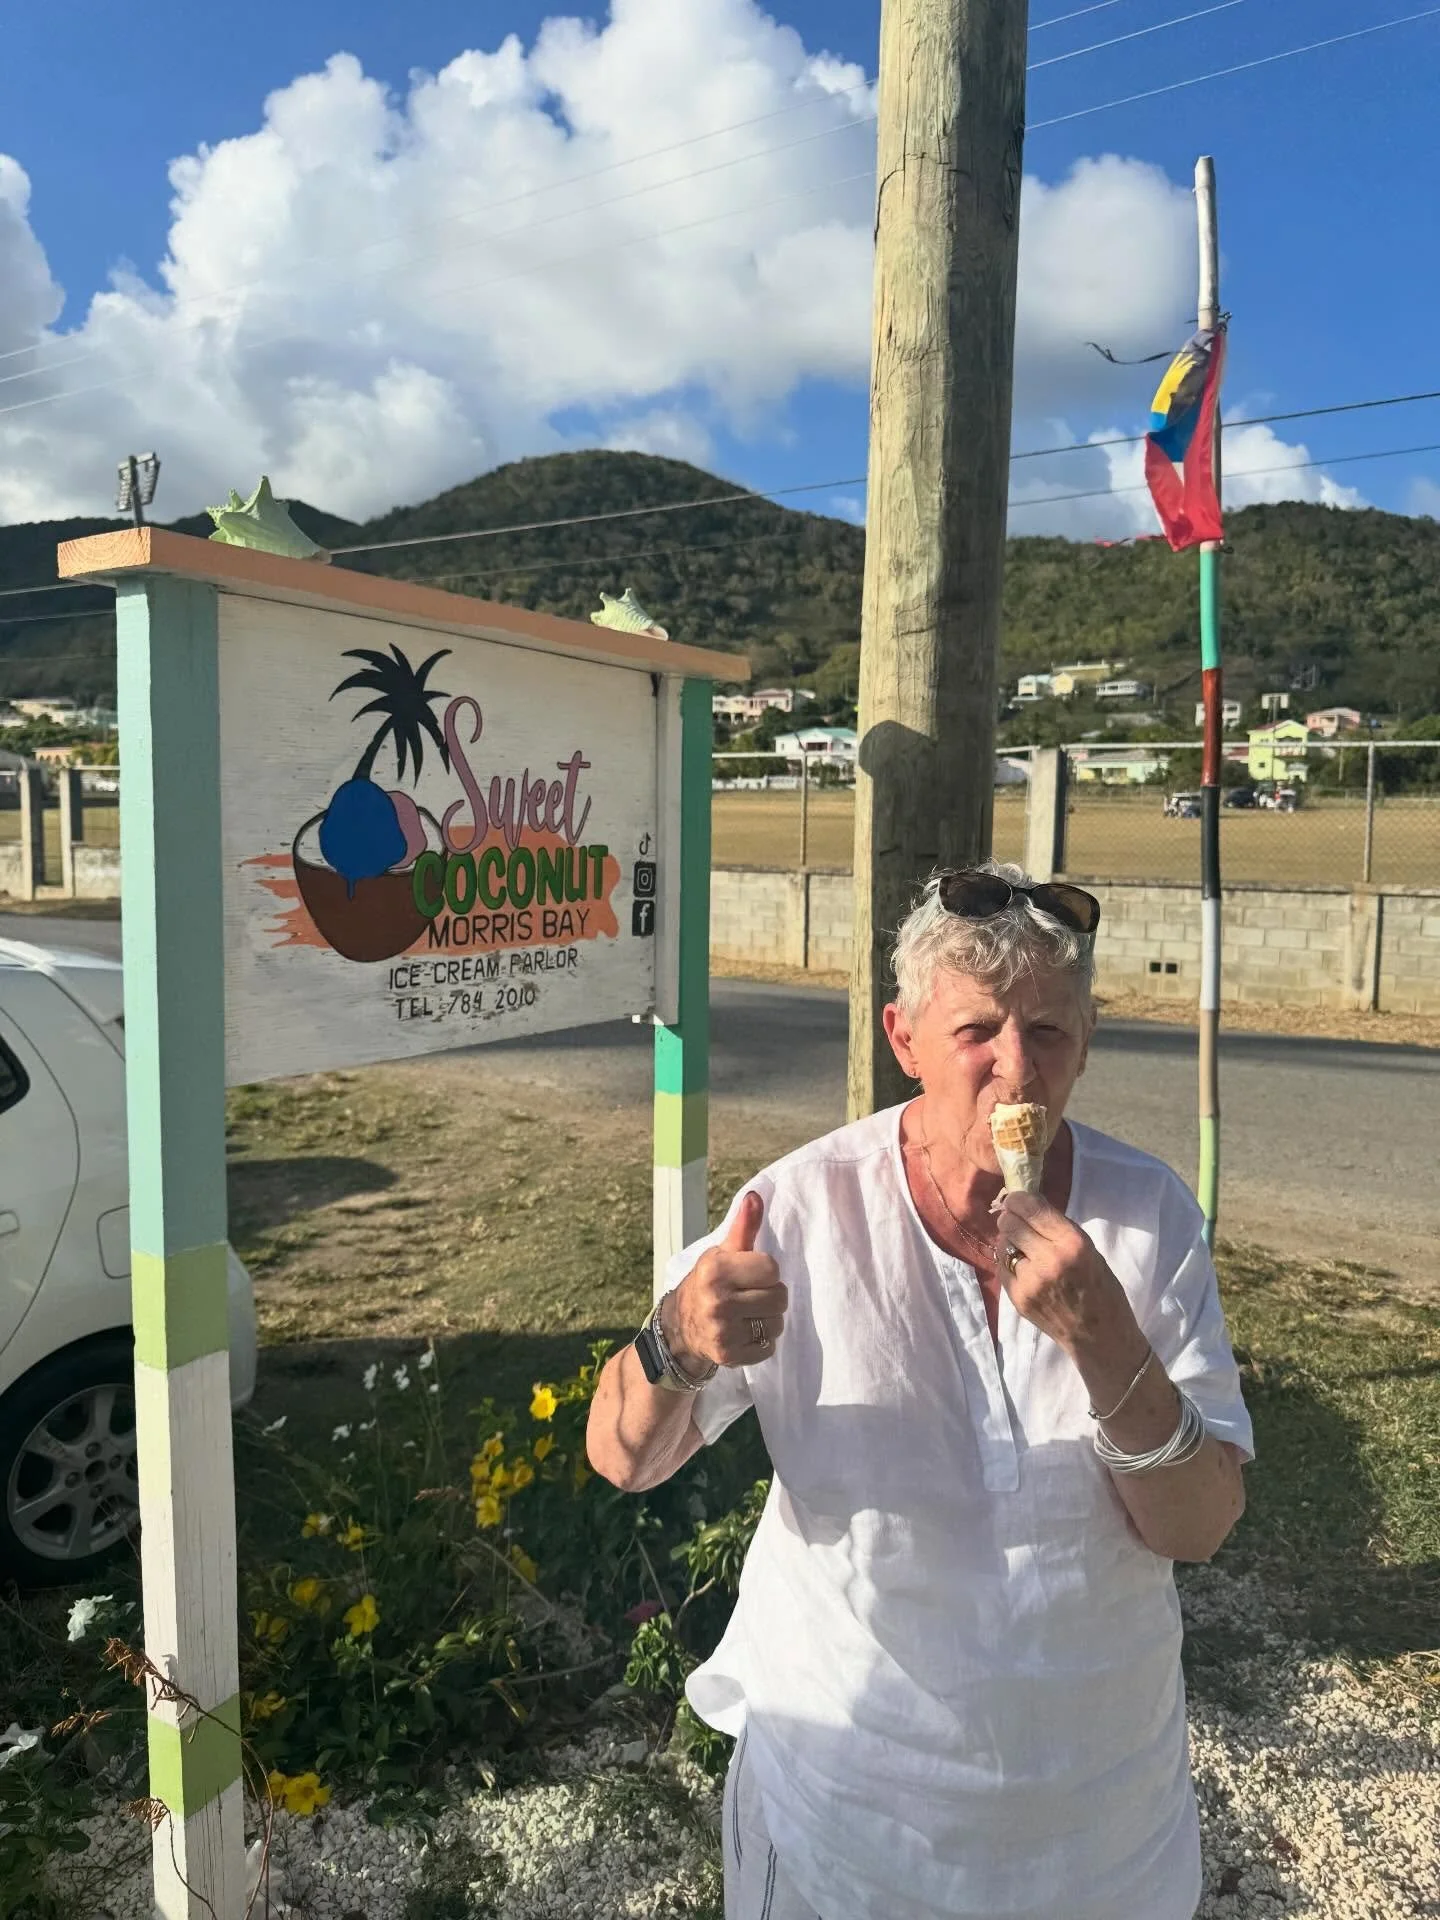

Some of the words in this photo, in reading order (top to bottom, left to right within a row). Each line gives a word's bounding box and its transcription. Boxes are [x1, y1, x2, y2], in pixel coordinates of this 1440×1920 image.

[442, 696, 592, 854] Sweet
[412, 845, 609, 919] COCONUT
[428, 912, 533, 949] MORRIS
[542, 908, 590, 938] BAY
[389, 957, 500, 990] ICE-CREAM
[509, 948, 578, 975] PARLOR
[448, 990, 483, 1015] 784
[496, 987, 537, 1011] 2010
